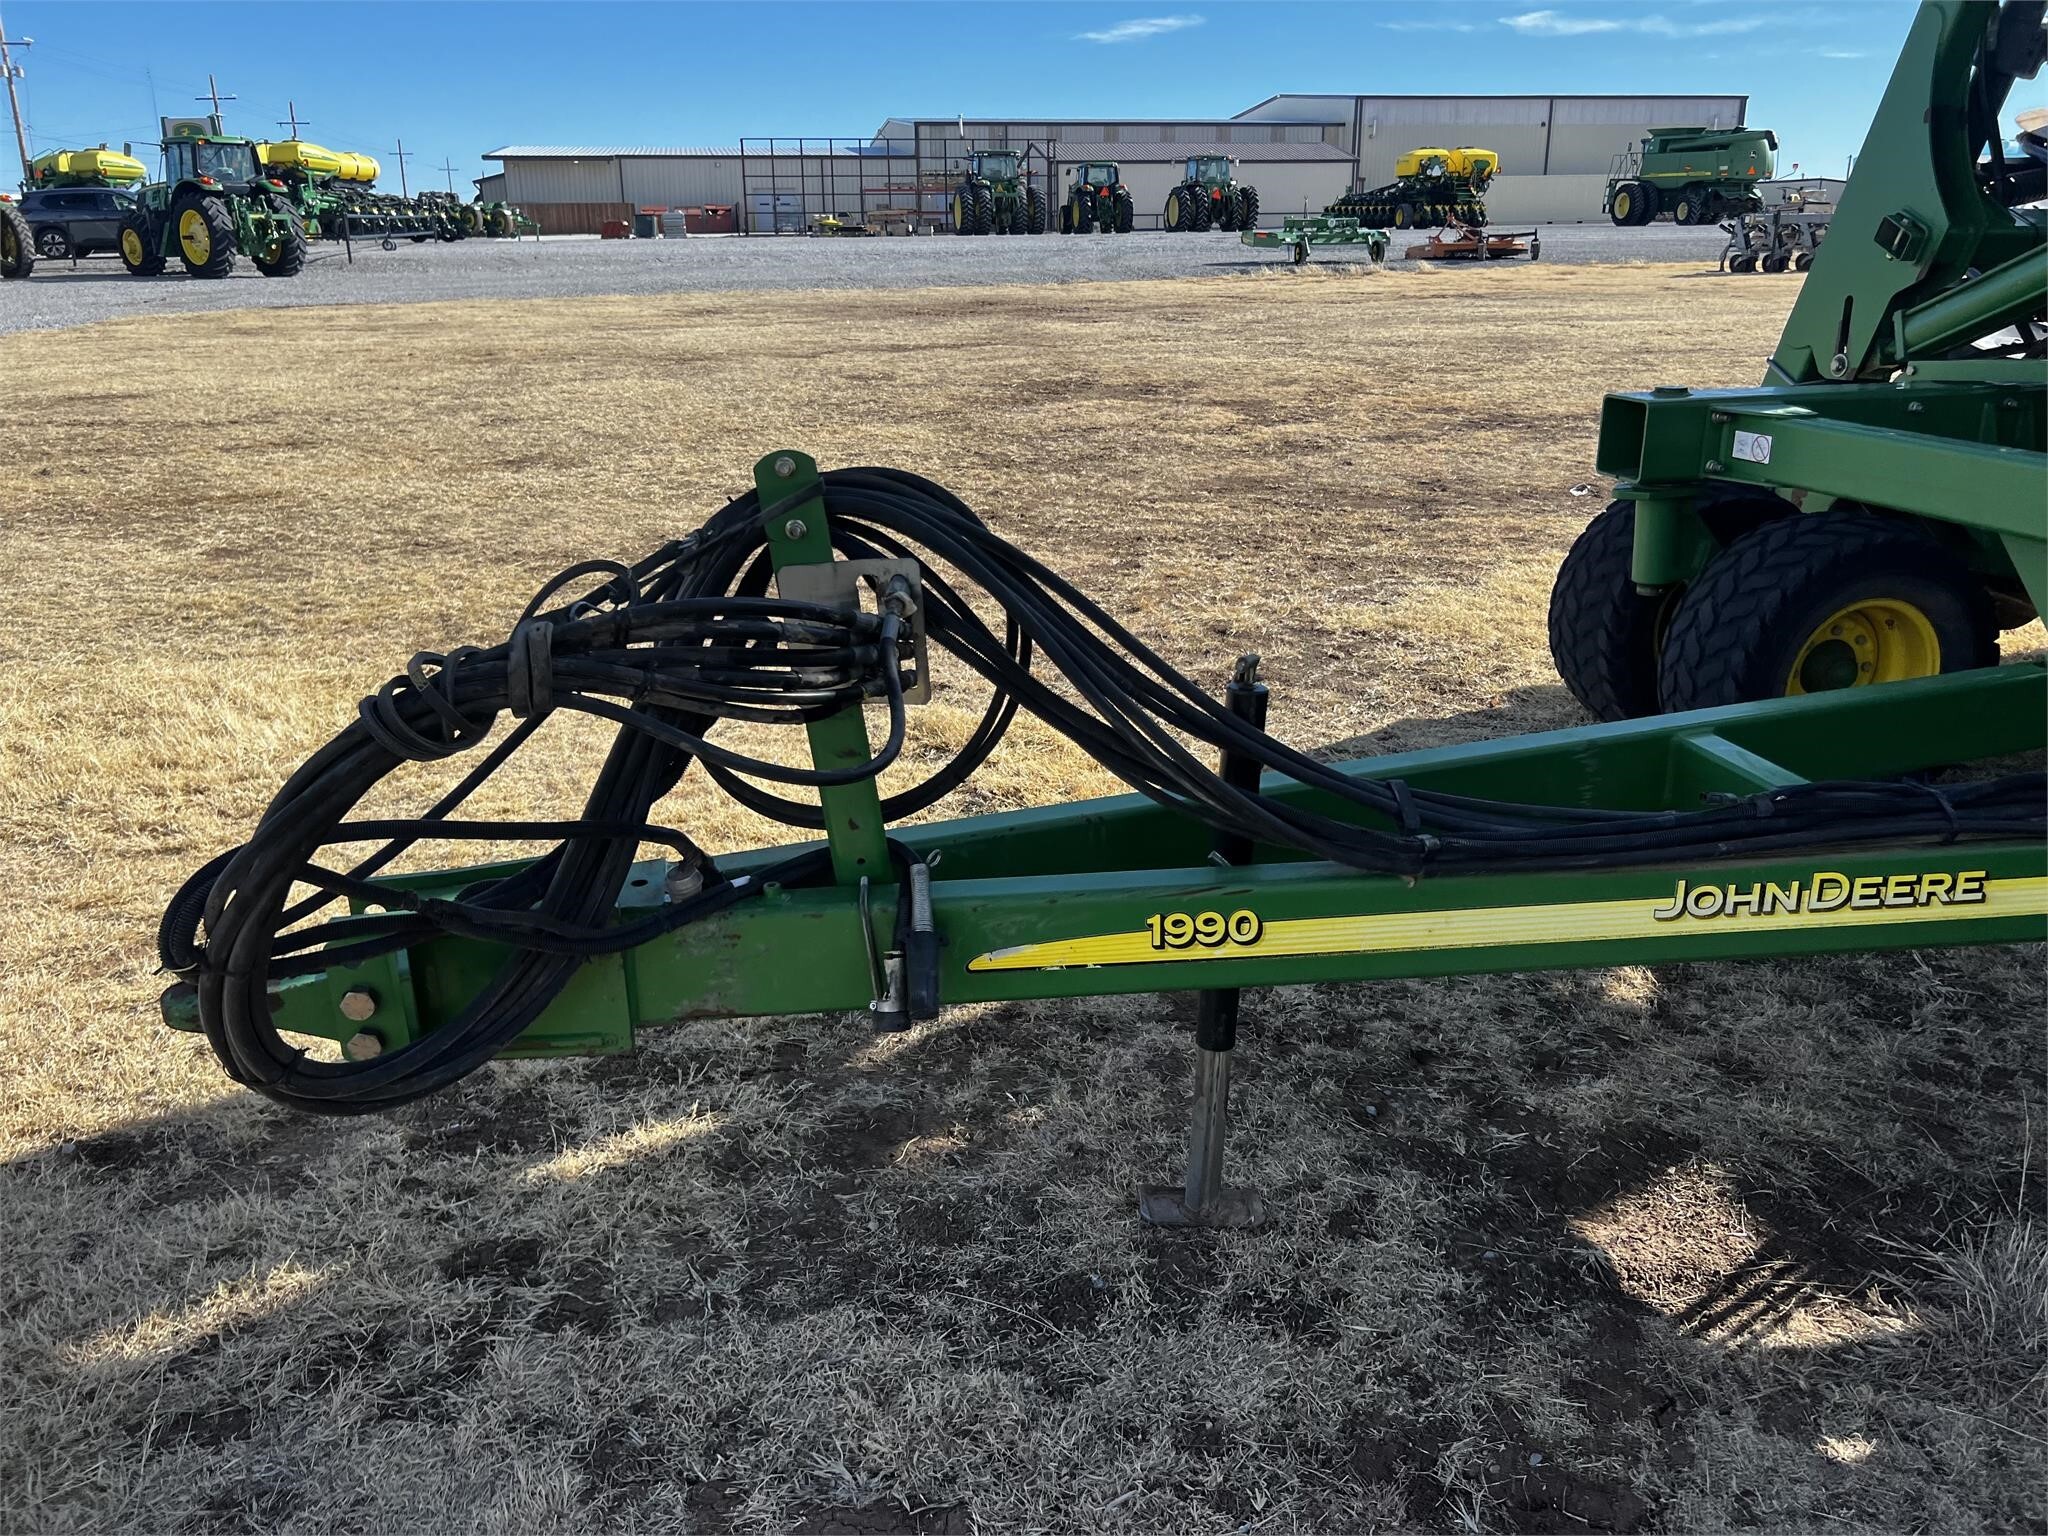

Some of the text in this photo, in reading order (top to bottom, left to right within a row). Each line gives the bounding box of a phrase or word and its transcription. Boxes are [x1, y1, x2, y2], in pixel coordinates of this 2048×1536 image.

[1654, 871, 1988, 920] JOHN DEERE
[1146, 909, 1263, 950] 1990
